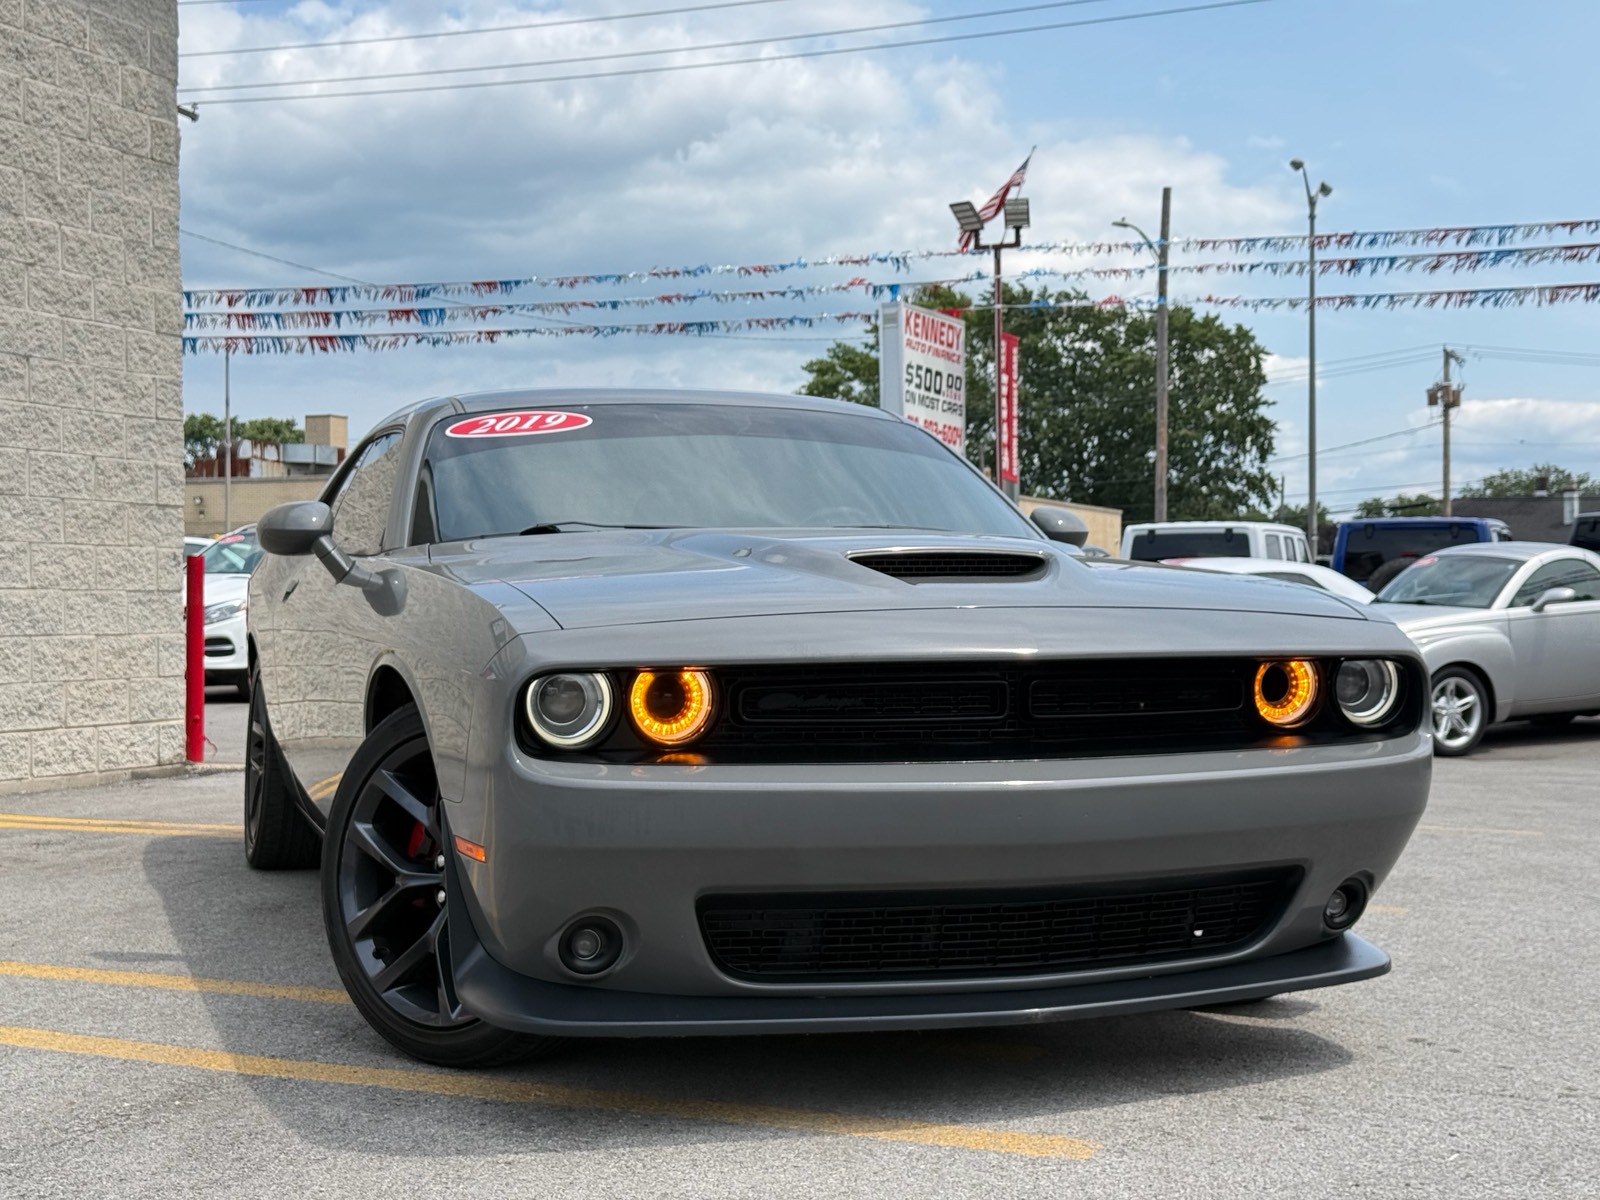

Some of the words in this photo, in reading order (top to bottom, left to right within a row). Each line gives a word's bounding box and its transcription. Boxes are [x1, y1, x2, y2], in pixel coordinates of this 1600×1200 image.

[905, 308, 962, 351] KENNEDY
[906, 338, 926, 353] AUTO
[926, 345, 962, 364] FINANCE
[905, 389, 916, 405] ON
[917, 393, 940, 411] MOST
[941, 400, 963, 417] CARS
[468, 414, 568, 435] 2019
